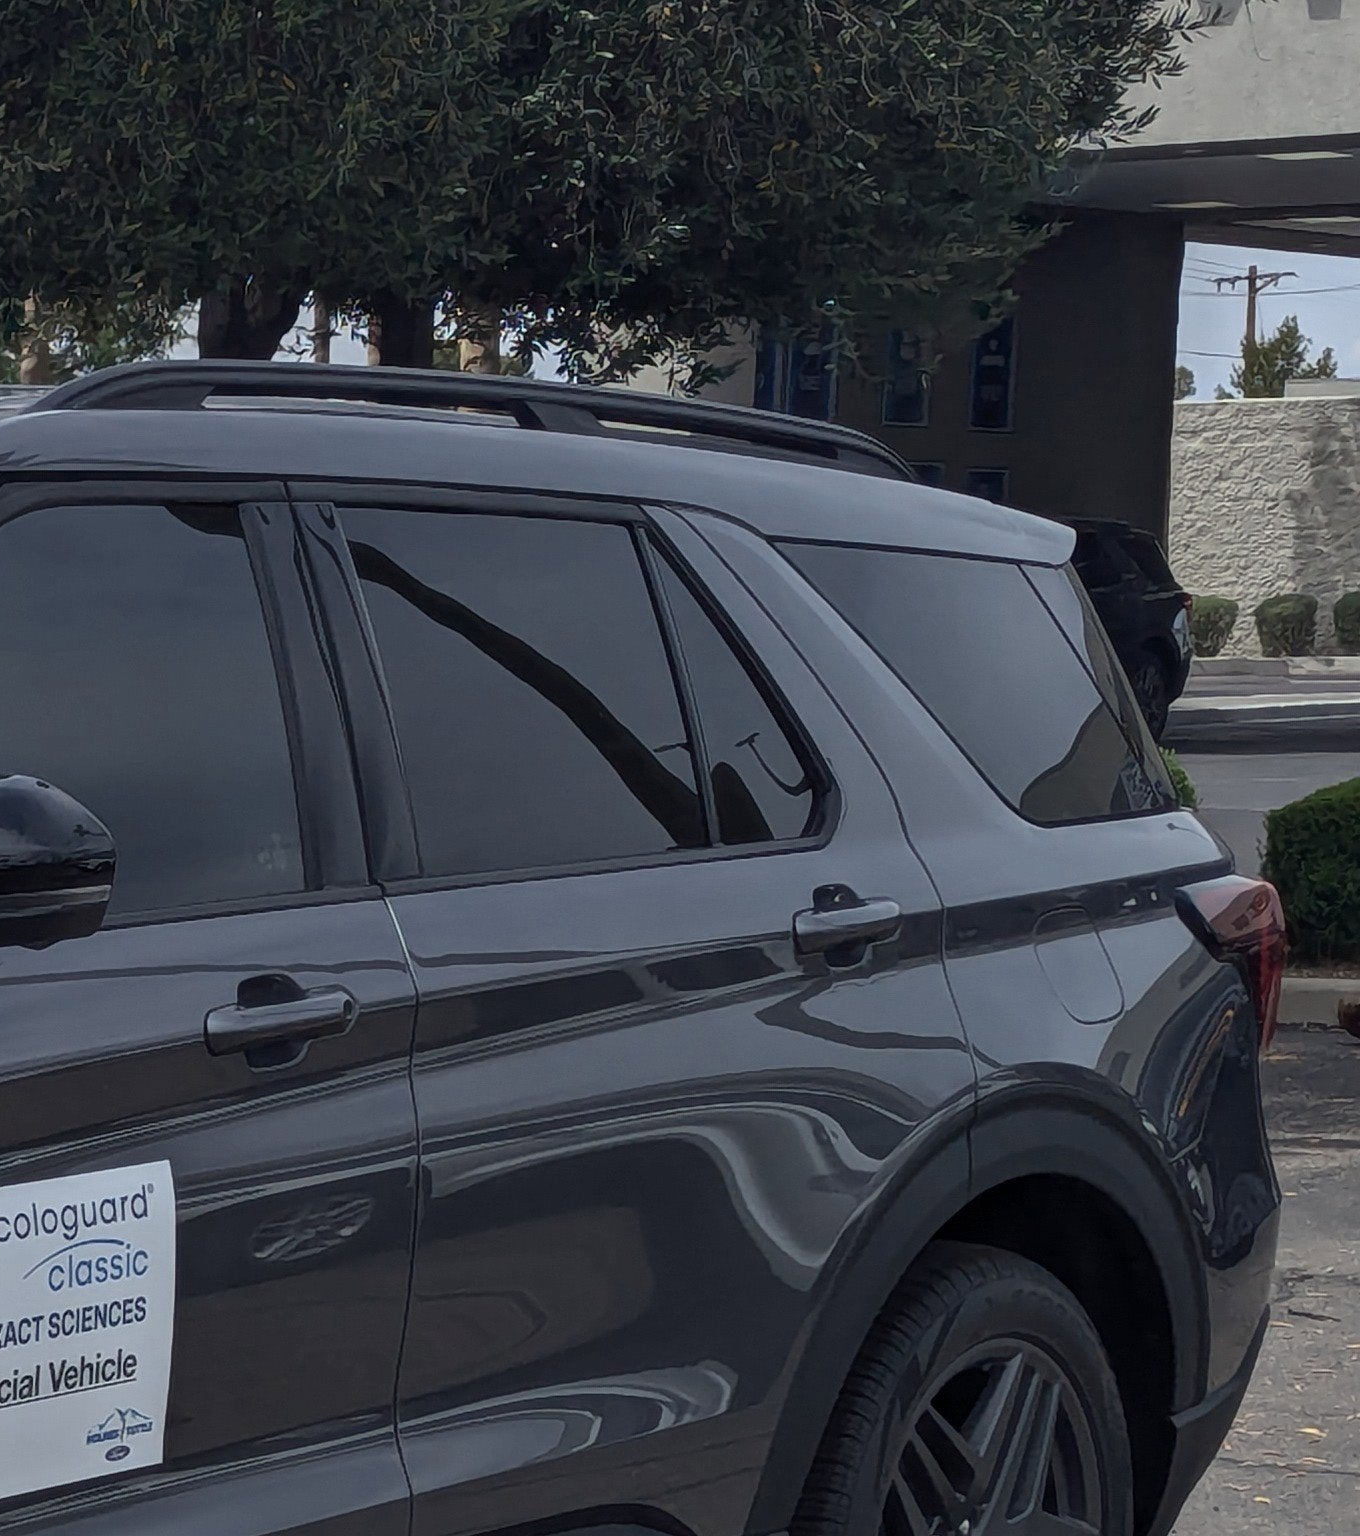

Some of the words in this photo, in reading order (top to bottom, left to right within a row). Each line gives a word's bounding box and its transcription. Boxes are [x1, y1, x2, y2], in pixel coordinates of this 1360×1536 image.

[47, 1243, 149, 1292] classic
[47, 1295, 148, 1340] SCIENCES
[48, 1347, 138, 1393] Vehicle
